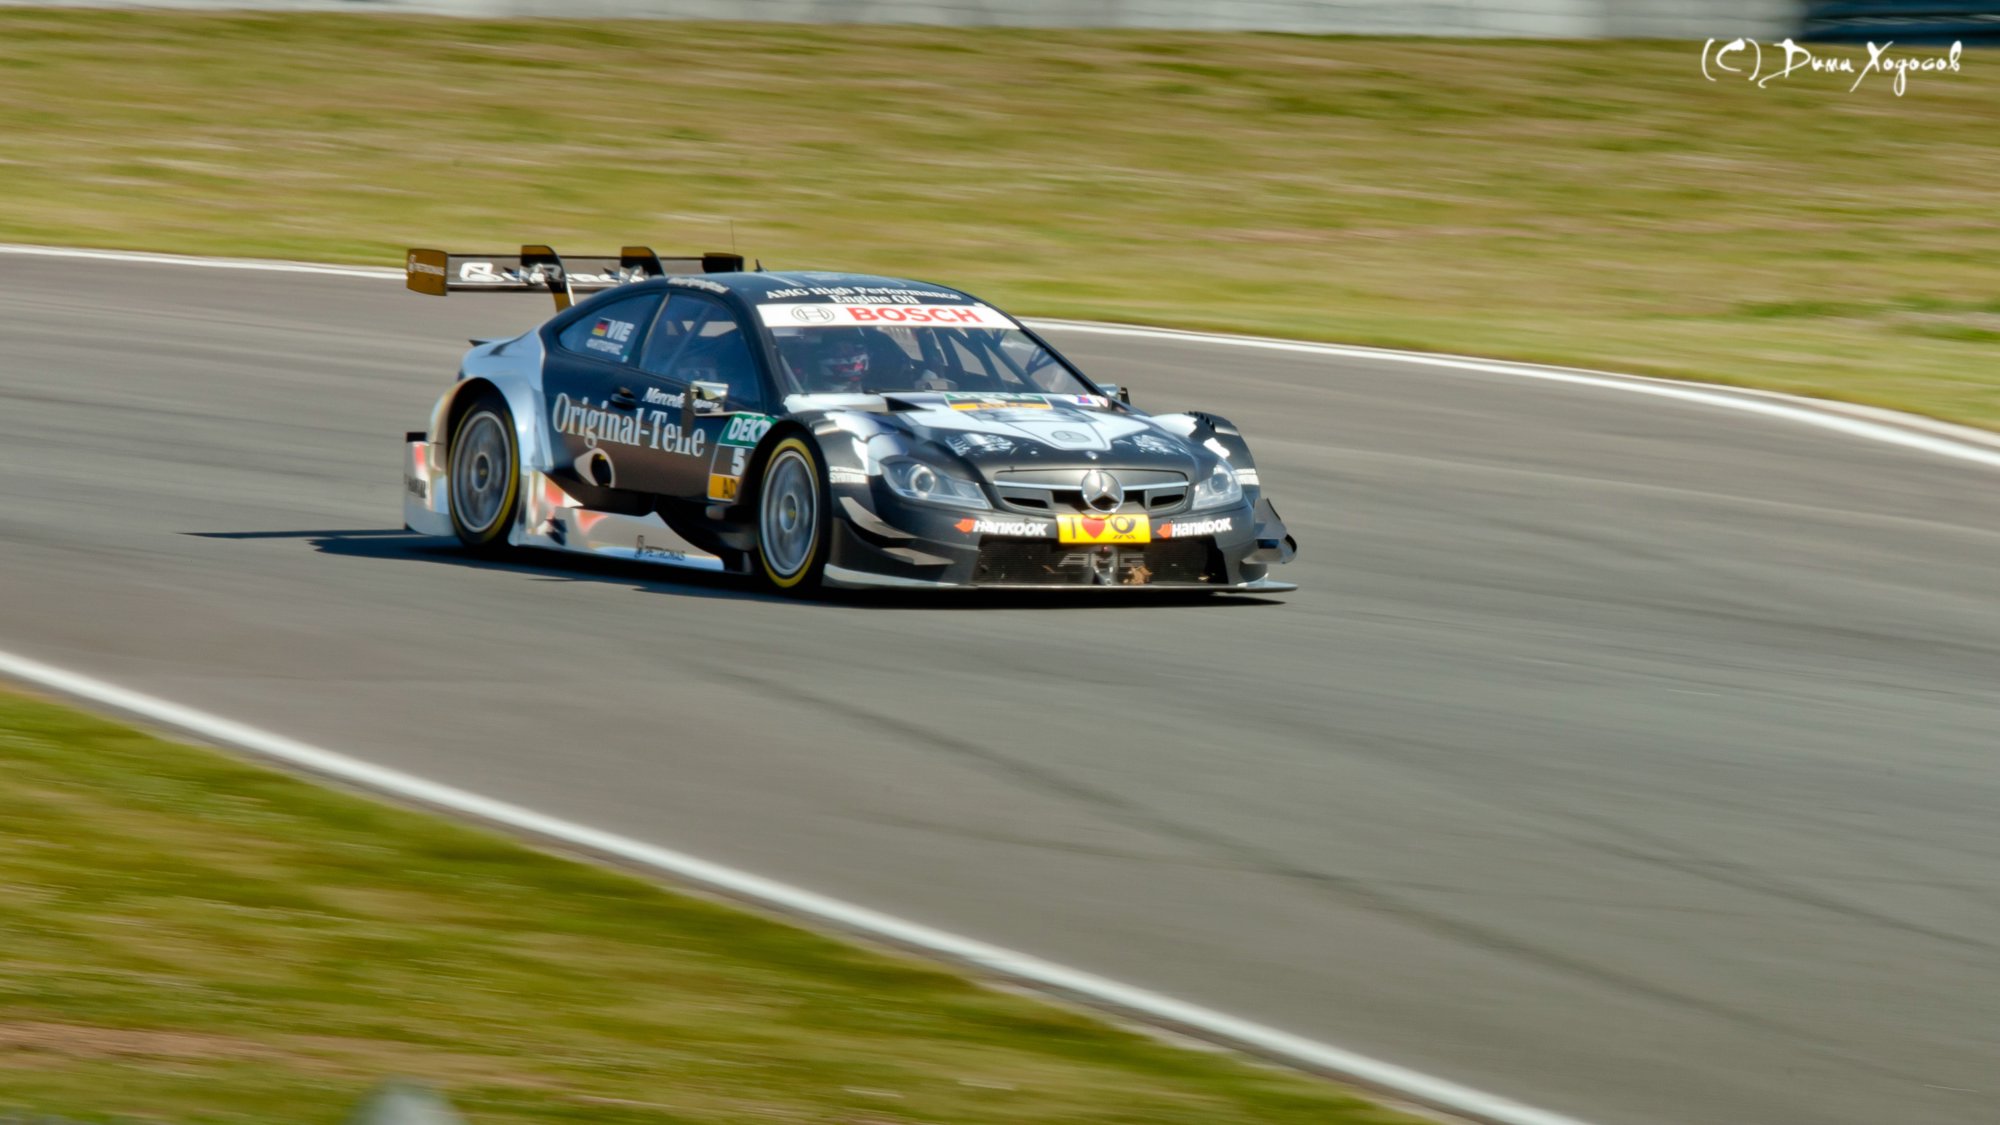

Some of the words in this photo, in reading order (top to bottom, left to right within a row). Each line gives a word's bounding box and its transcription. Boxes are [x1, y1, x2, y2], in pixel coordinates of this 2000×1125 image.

[766, 288, 809, 299] AMG
[810, 287, 854, 297] High
[854, 286, 962, 301] Performance
[830, 294, 892, 305] Engine
[892, 295, 920, 305] Oil
[846, 307, 983, 323] BOSCH
[606, 319, 635, 342] VIE
[731, 447, 745, 476] 5
